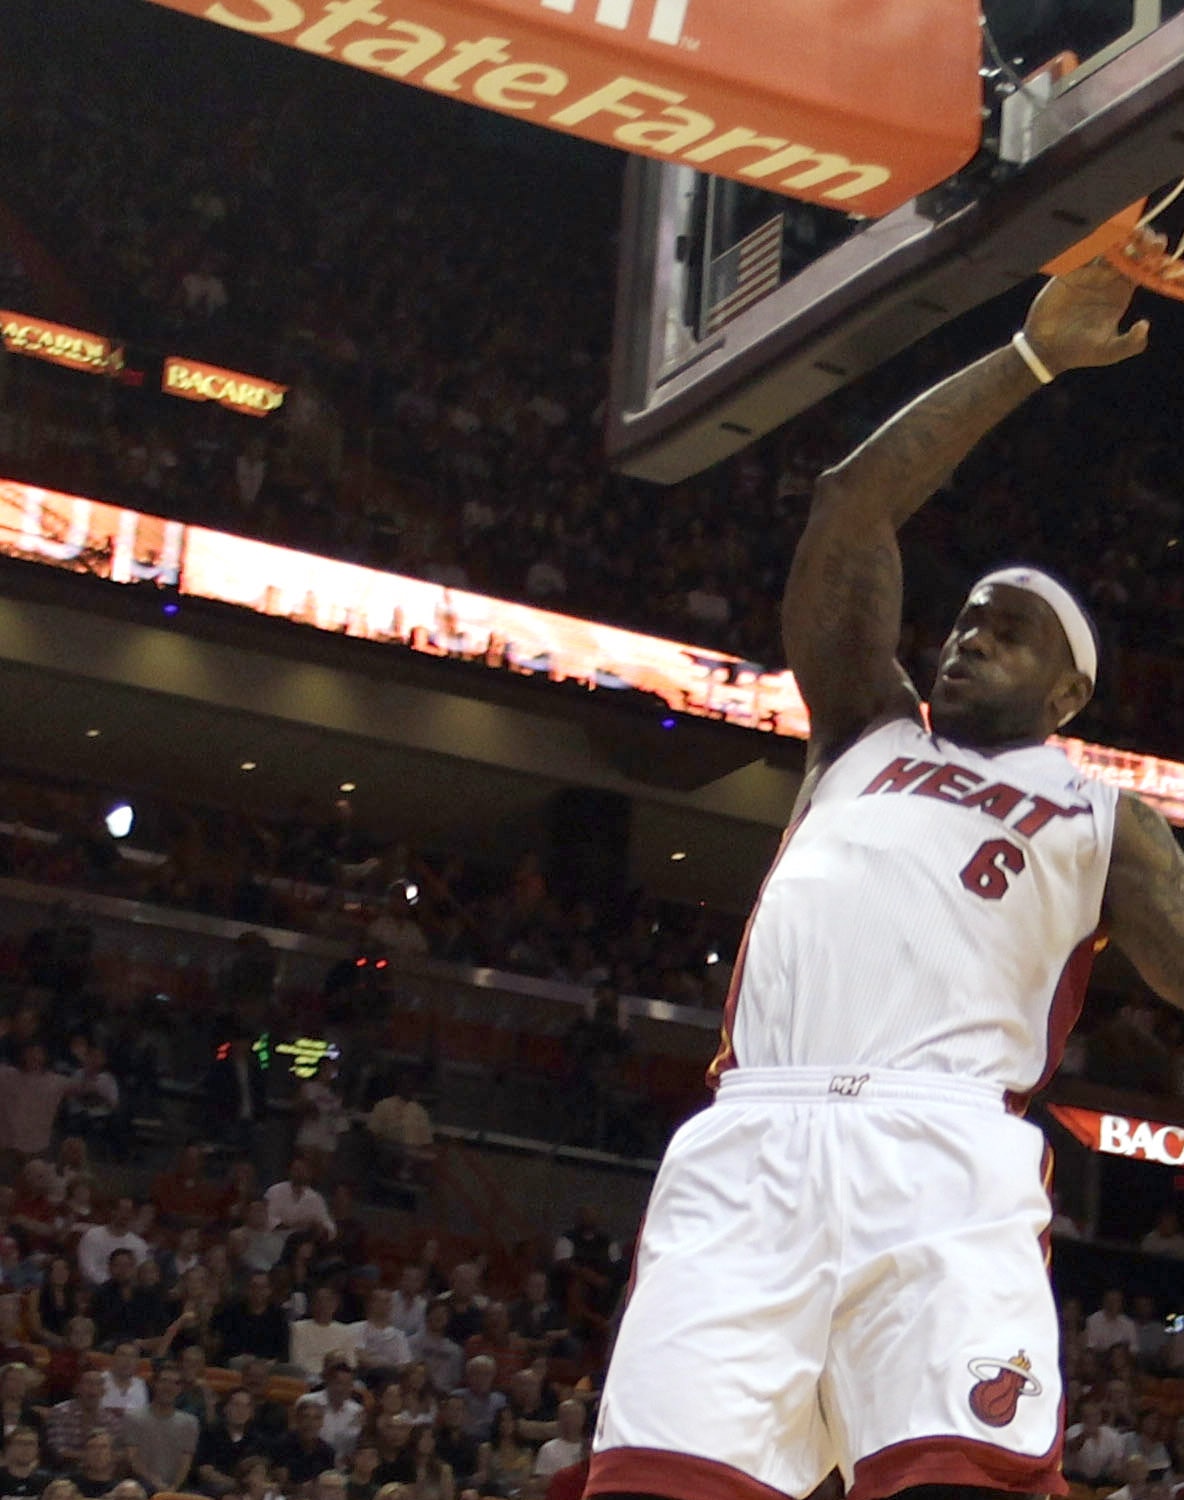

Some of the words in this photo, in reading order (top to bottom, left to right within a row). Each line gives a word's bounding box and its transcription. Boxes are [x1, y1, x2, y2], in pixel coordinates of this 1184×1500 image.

[204, 0, 568, 110] State
[549, 76, 891, 200] Farm
[857, 757, 1093, 838] HEAT
[959, 838, 1026, 900] 6
